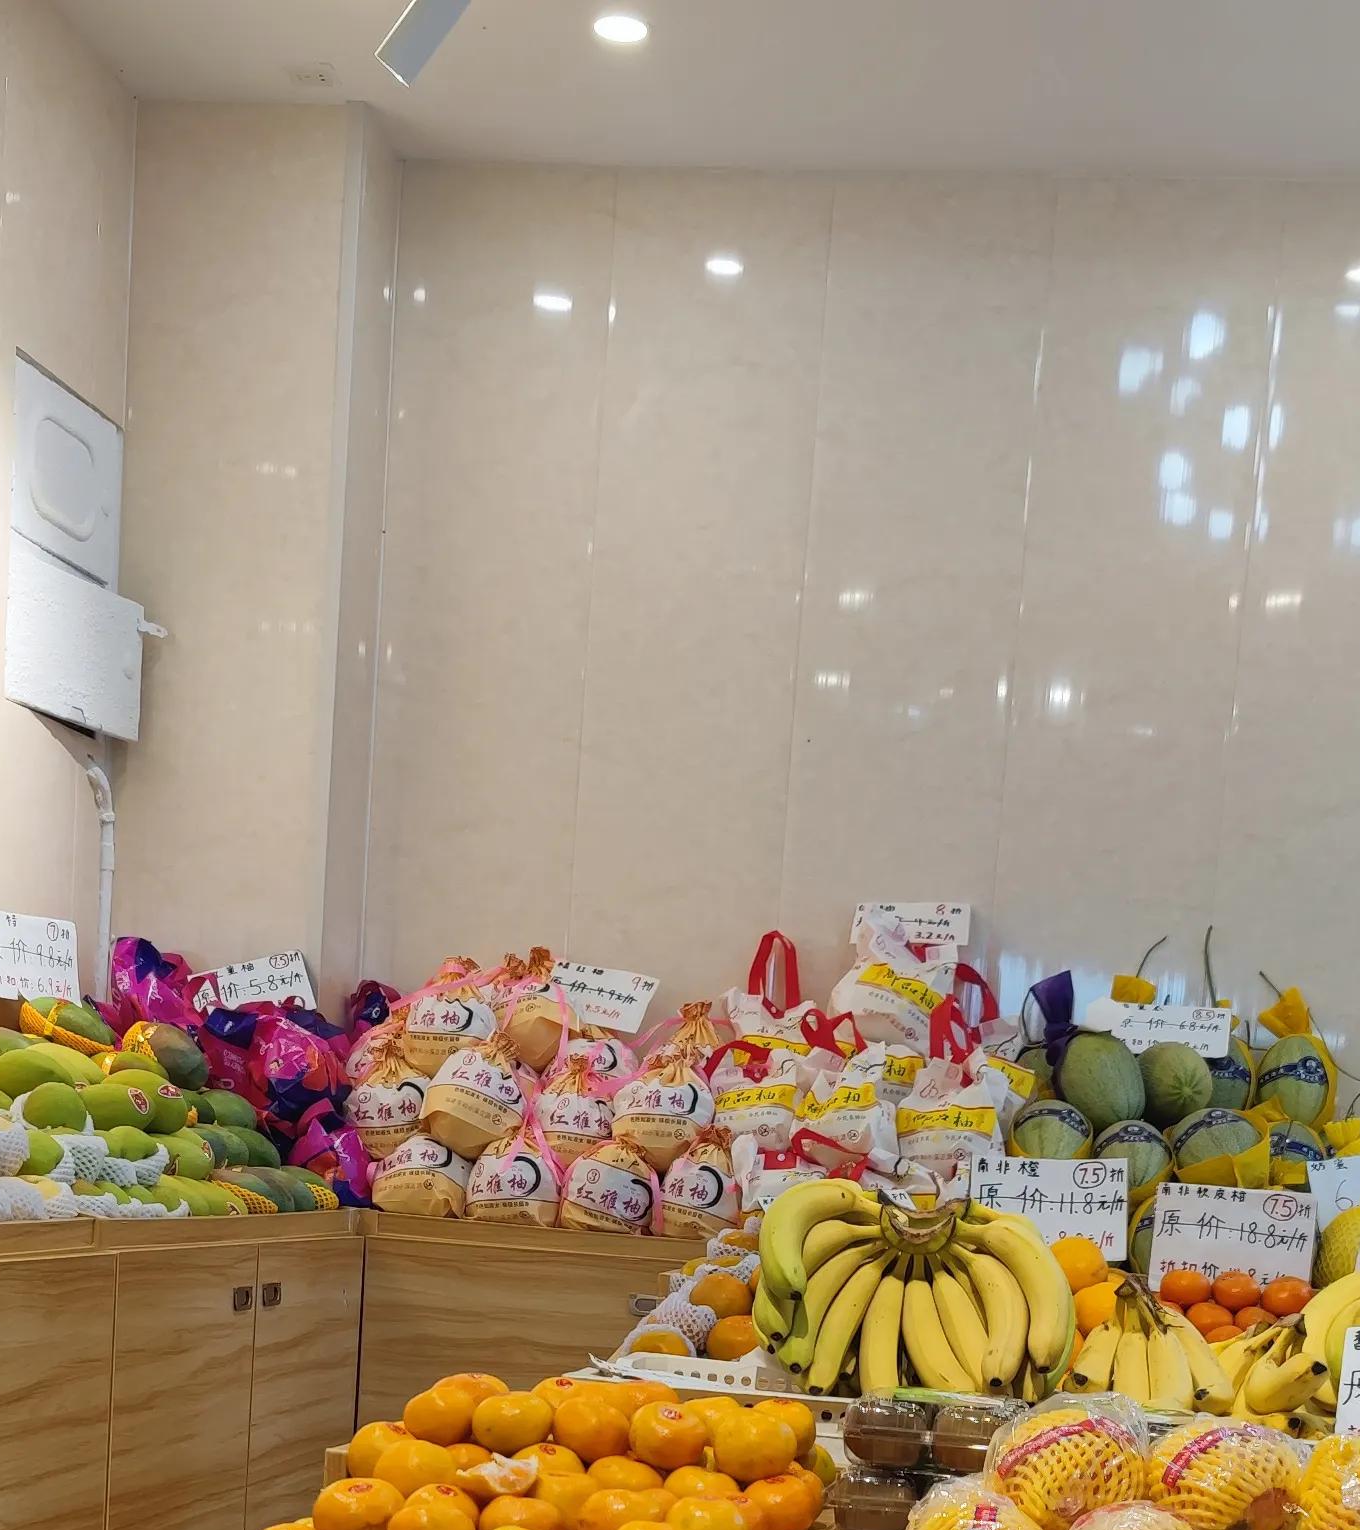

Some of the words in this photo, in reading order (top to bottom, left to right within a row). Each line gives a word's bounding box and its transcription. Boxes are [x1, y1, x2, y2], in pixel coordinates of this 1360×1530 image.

[354, 1100, 417, 1122] 红雅柚
[978, 1157, 1040, 1178] 南非橙
[1075, 1164, 1125, 1187] 7.5折
[471, 1173, 528, 1196] 红雅柚
[576, 1182, 641, 1215] 红雅柚
[1267, 1196, 1312, 1220] 7.5折
[1156, 1209, 1309, 1252] 原价:18.8元/斤
